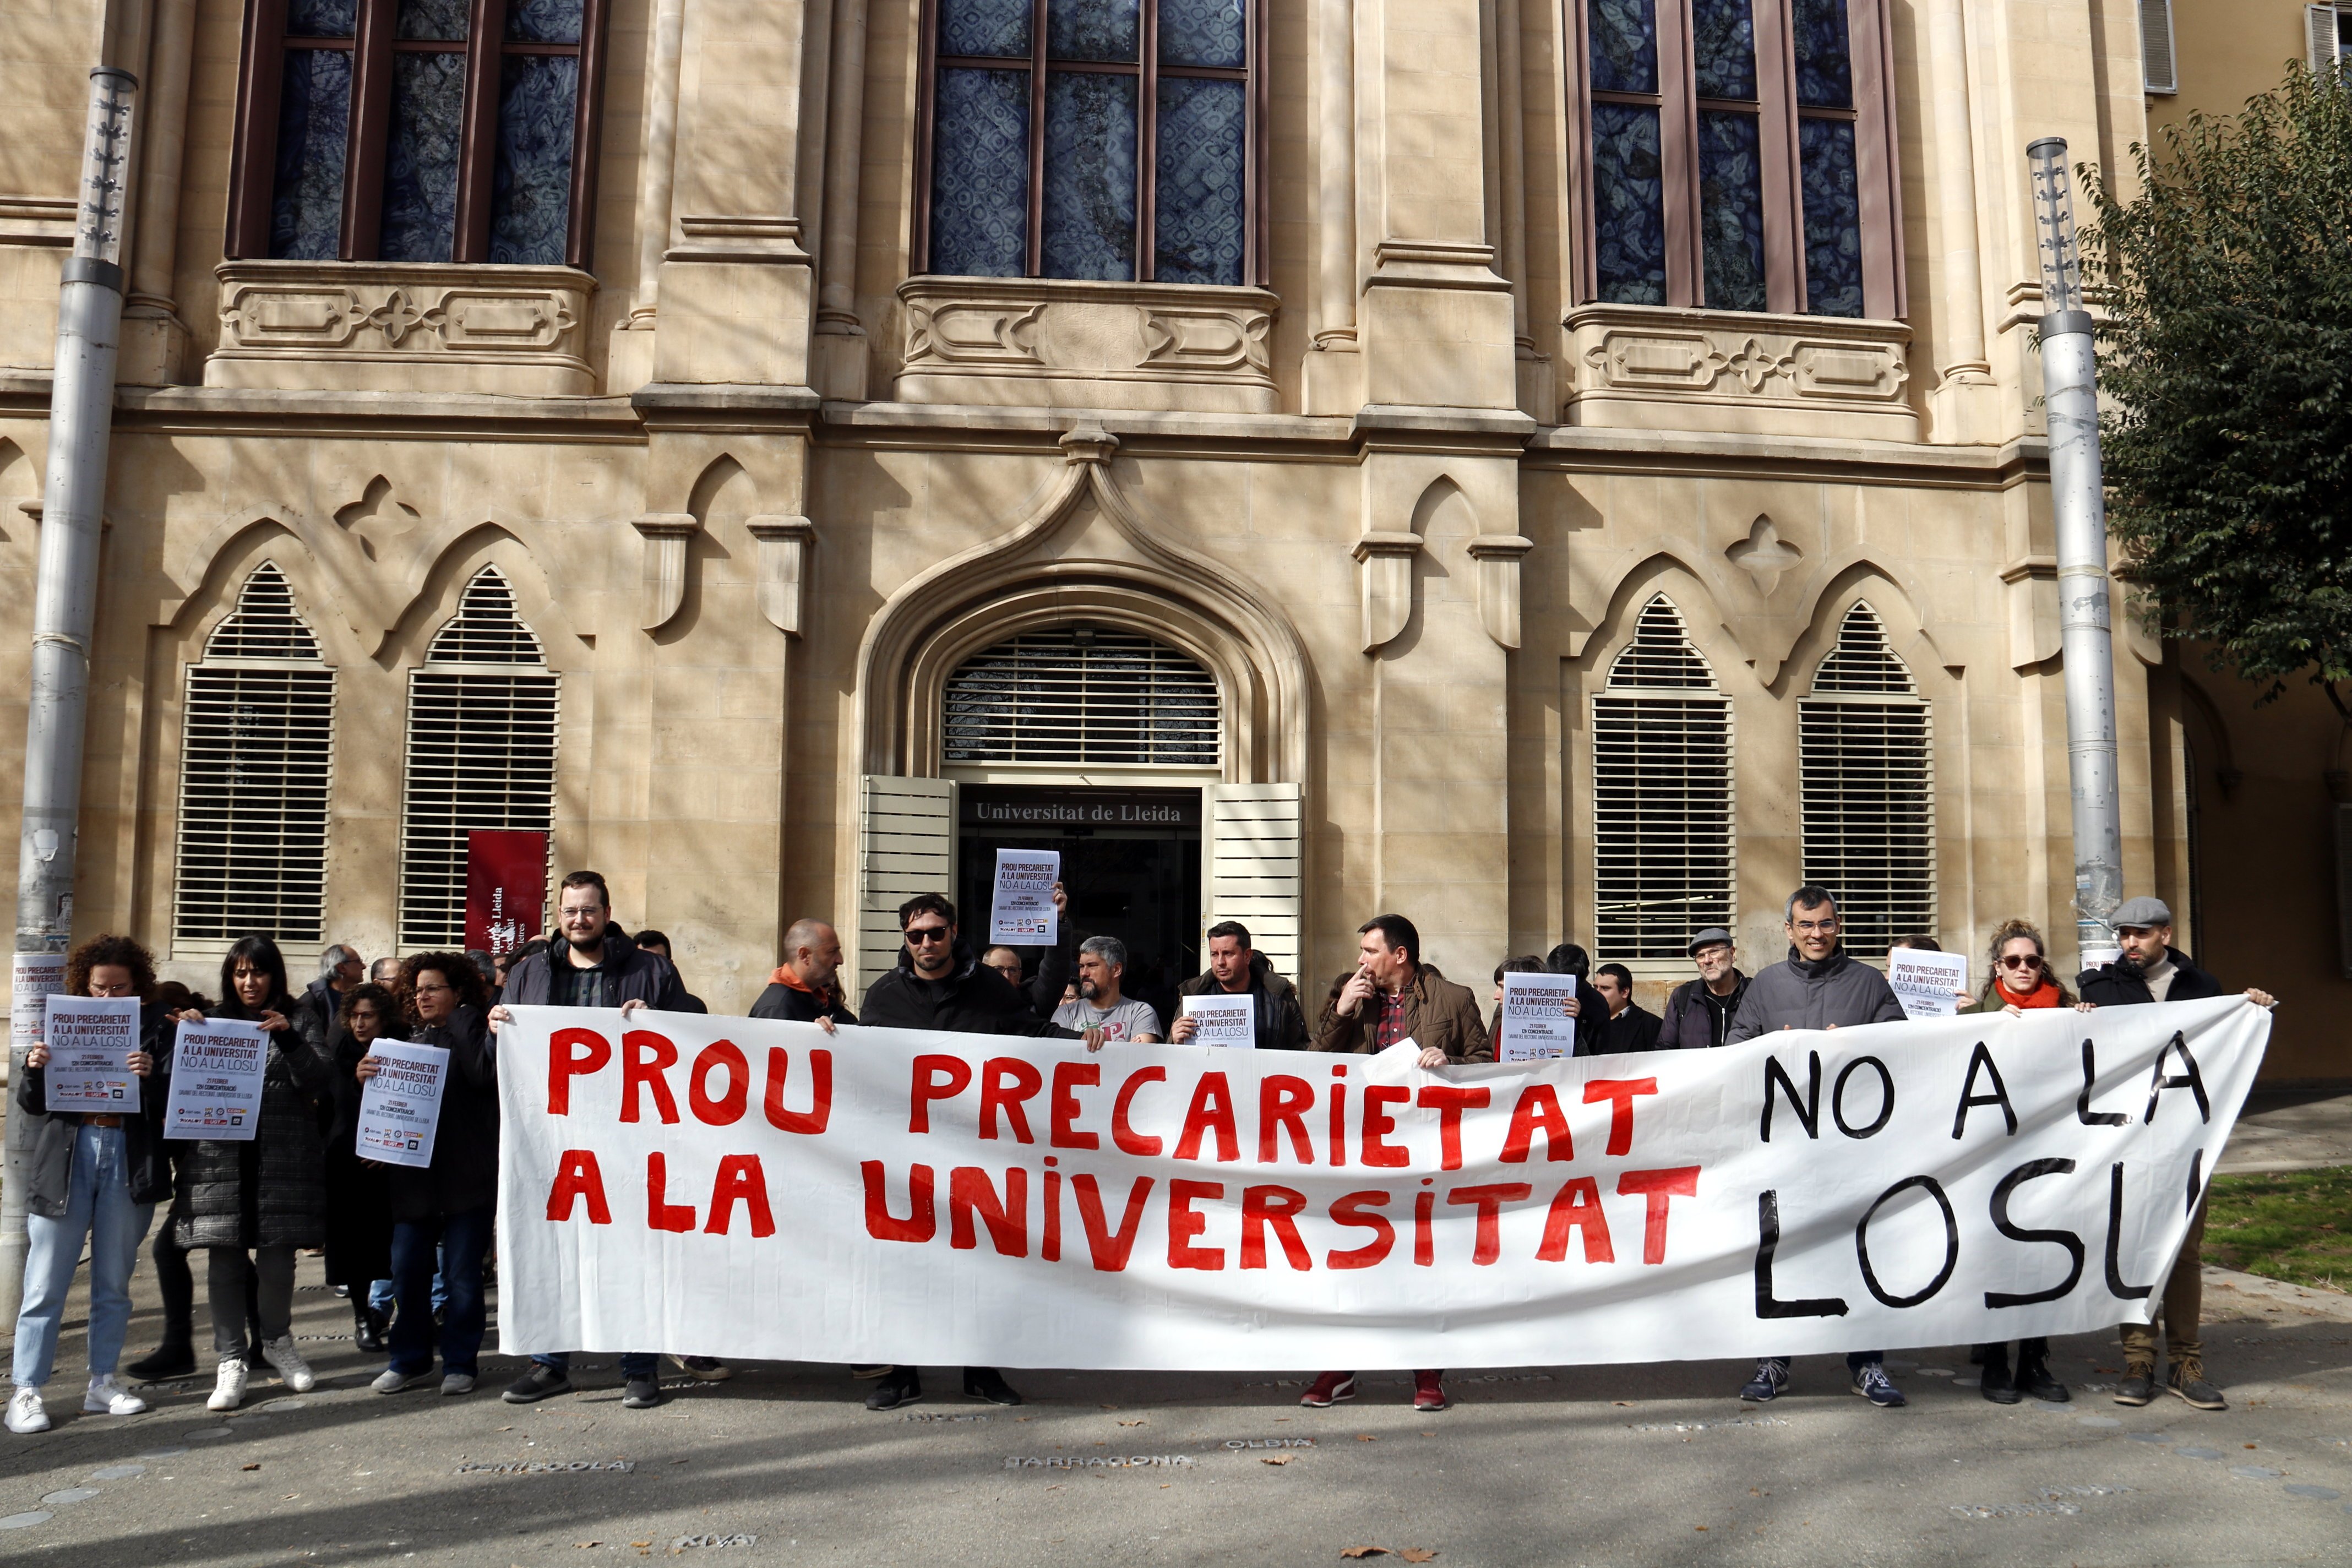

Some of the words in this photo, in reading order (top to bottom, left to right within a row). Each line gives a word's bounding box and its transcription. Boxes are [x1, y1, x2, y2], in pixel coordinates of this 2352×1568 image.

[976, 803, 1084, 820] Universitat
[1091, 805, 1113, 820] de
[1120, 805, 1180, 821] Lleida
[1033, 881, 1053, 890] LOSU
[492, 888, 502, 919] Lleida
[1897, 964, 1915, 973] PROU
[1917, 966, 1959, 977] PRECARIETAT
[1894, 982, 1908, 991] NO
[1910, 984, 1917, 992] A
[1920, 986, 1931, 994] LA
[1914, 976, 1958, 987] UNIVERSITAT
[1528, 988, 1569, 997] PRECARIETAT
[1189, 1010, 1205, 1019] PROU
[1207, 1009, 1246, 1018] PRECARIETAT
[1509, 1006, 1521, 1015] NO
[1523, 1006, 1529, 1015] A
[1532, 1007, 1542, 1016] LA
[53, 1014, 75, 1023] PROU
[77, 1015, 131, 1024] PRECARIETAT
[1206, 1019, 1246, 1027] UNIVERSITAT
[54, 1025, 59, 1034] A
[62, 1025, 72, 1034] LA
[75, 1026, 130, 1035] UNIVERSITAT
[1204, 1028, 1210, 1037] A
[1212, 1028, 1223, 1037] LA
[1225, 1027, 1248, 1037] LOSU
[52, 1036, 69, 1046] NO
[72, 1036, 80, 1046] A
[83, 1036, 97, 1046] LA
[101, 1036, 132, 1047] LOSU
[184, 1034, 206, 1044] PROU
[208, 1036, 260, 1048] PRECARIETAT
[183, 1046, 189, 1054] A
[192, 1047, 202, 1055] LA
[205, 1047, 258, 1059] UNIVERSITAT
[181, 1056, 198, 1068] NO
[199, 1058, 208, 1068] A
[211, 1058, 225, 1069] LA
[228, 1059, 258, 1071] LOSU
[391, 1058, 440, 1074] PRECARIETAT
[389, 1069, 437, 1085] UNIVERSITAT
[547, 1027, 833, 1135] PROU
[370, 1077, 383, 1088] NO
[384, 1080, 390, 1090] A
[393, 1080, 405, 1092] LA
[408, 1083, 437, 1097] LOSU
[1761, 1049, 1895, 1143] NO
[1951, 1041, 2019, 1141] A
[2077, 1030, 2210, 1126] LA
[546, 1149, 612, 1226] A
[647, 1151, 776, 1238] LA
[1755, 1148, 2204, 1319] LOSU
[1225, 1438, 1313, 1450] OLBIA
[1009, 1455, 1194, 1468] TARRAGONA
